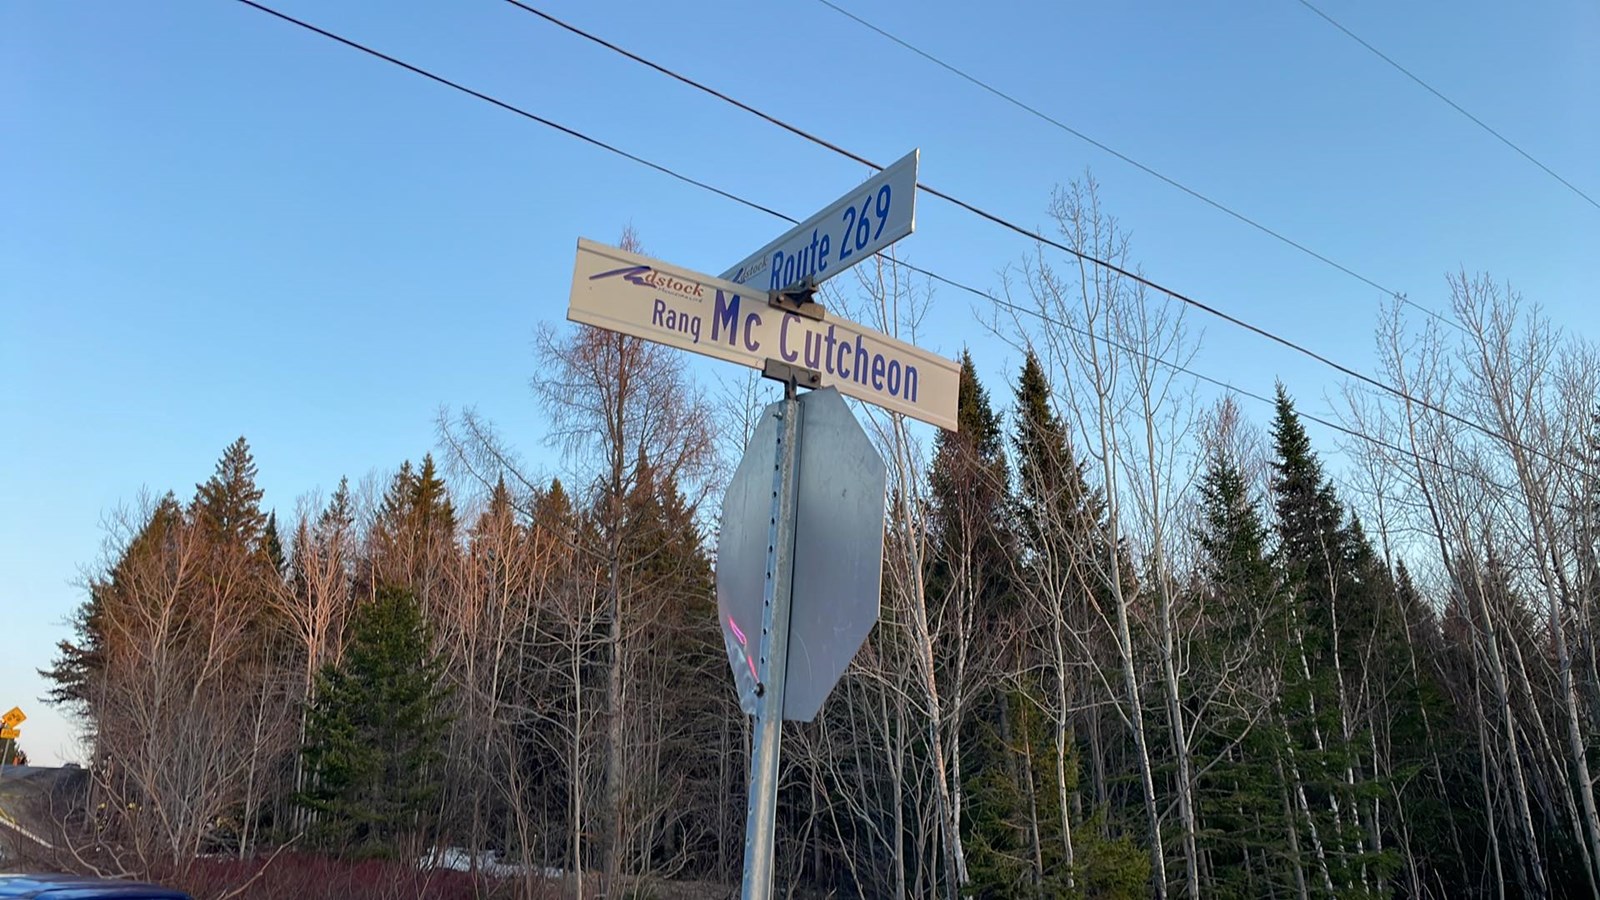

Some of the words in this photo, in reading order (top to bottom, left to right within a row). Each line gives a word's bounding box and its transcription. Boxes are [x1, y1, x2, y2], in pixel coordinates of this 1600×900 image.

[770, 228, 830, 290] Route
[839, 184, 892, 261] 269
[652, 298, 701, 344] Rang
[711, 288, 762, 352] Mc
[780, 311, 918, 402] Cutcheon
